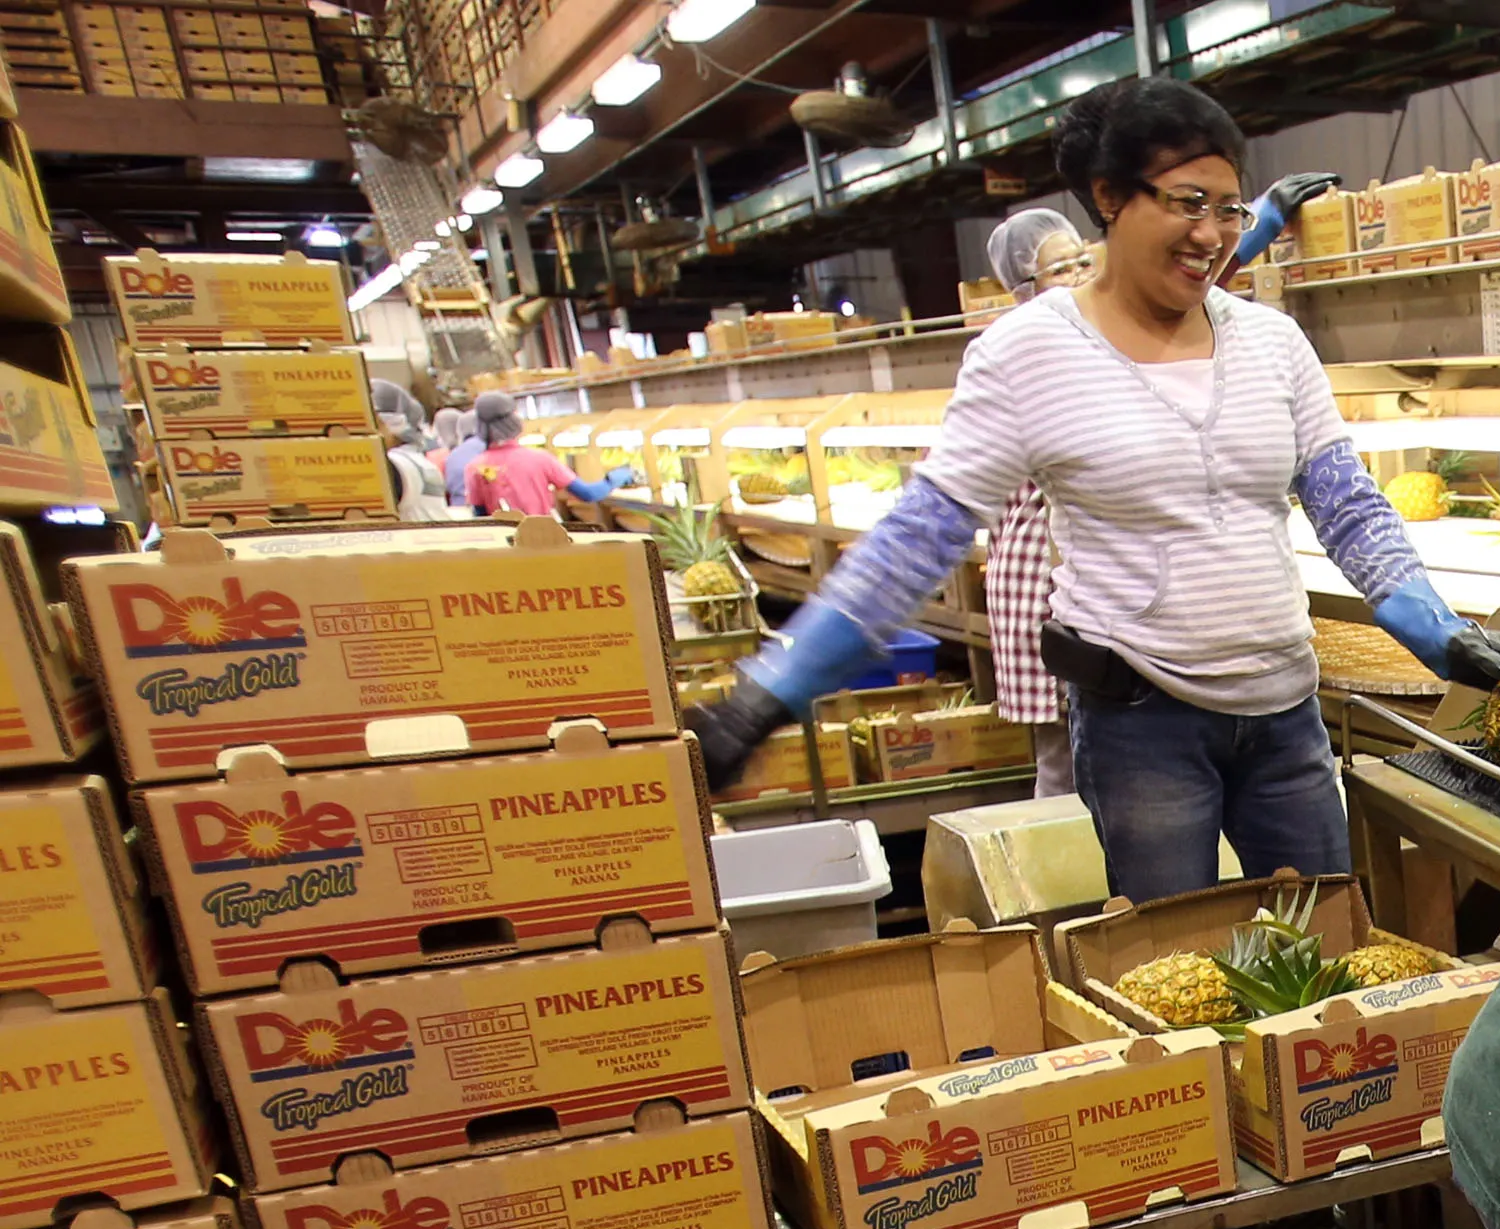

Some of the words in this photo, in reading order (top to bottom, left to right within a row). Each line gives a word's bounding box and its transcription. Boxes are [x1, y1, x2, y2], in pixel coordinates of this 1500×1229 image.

[1458, 175, 1491, 206] Dole
[119, 266, 195, 297] Dole
[147, 360, 221, 389] Dole
[172, 446, 243, 473] Dole
[107, 576, 300, 647] Dole
[439, 585, 627, 617] PINEAPPLES
[137, 663, 242, 717] Tropical
[241, 653, 301, 697] Gold
[884, 725, 933, 747] Dole
[488, 780, 668, 820] PINEAPPLES
[172, 789, 356, 863] Dole
[202, 874, 302, 928] Tropical
[301, 862, 358, 906] Gold
[534, 972, 705, 1017] PINEAPPLES
[1361, 985, 1411, 1009] Tropical
[1409, 976, 1444, 996] Gold
[1447, 970, 1500, 988] Dole
[234, 998, 408, 1072] Dole
[1293, 1026, 1397, 1086] Dole
[938, 1067, 1001, 1097] Tropical
[1000, 1056, 1039, 1081] Gold
[1048, 1049, 1110, 1070] Dole
[261, 1078, 357, 1130] Tropical
[355, 1064, 409, 1107] Gold
[1076, 1080, 1206, 1127] PINEAPPLES
[1300, 1089, 1359, 1132] Tropical
[1358, 1077, 1392, 1112] Gold
[570, 1150, 734, 1199] PINEAPPLES
[847, 1119, 979, 1187] Dole
[936, 1172, 977, 1211] Gold
